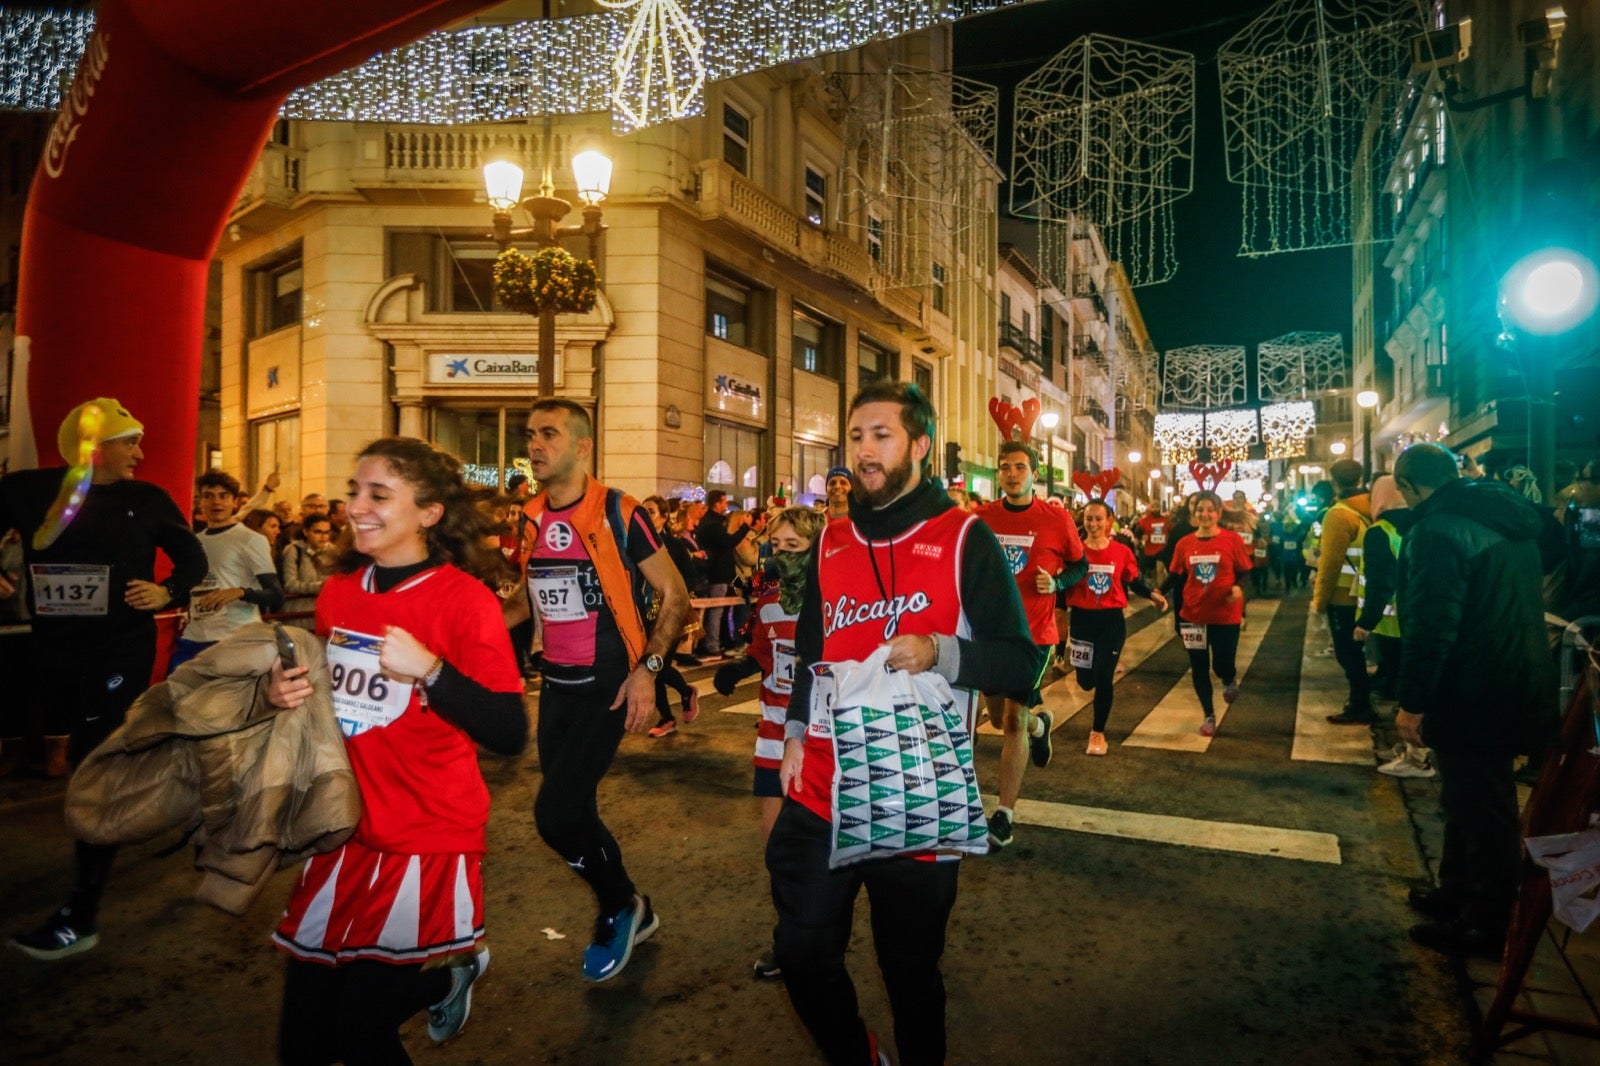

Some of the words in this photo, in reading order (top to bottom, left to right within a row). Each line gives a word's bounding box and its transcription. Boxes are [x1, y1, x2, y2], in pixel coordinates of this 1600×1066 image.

[43, 585, 99, 600] 1137
[538, 588, 569, 605] 957
[823, 592, 932, 641] Chicago
[331, 663, 390, 702] 906
